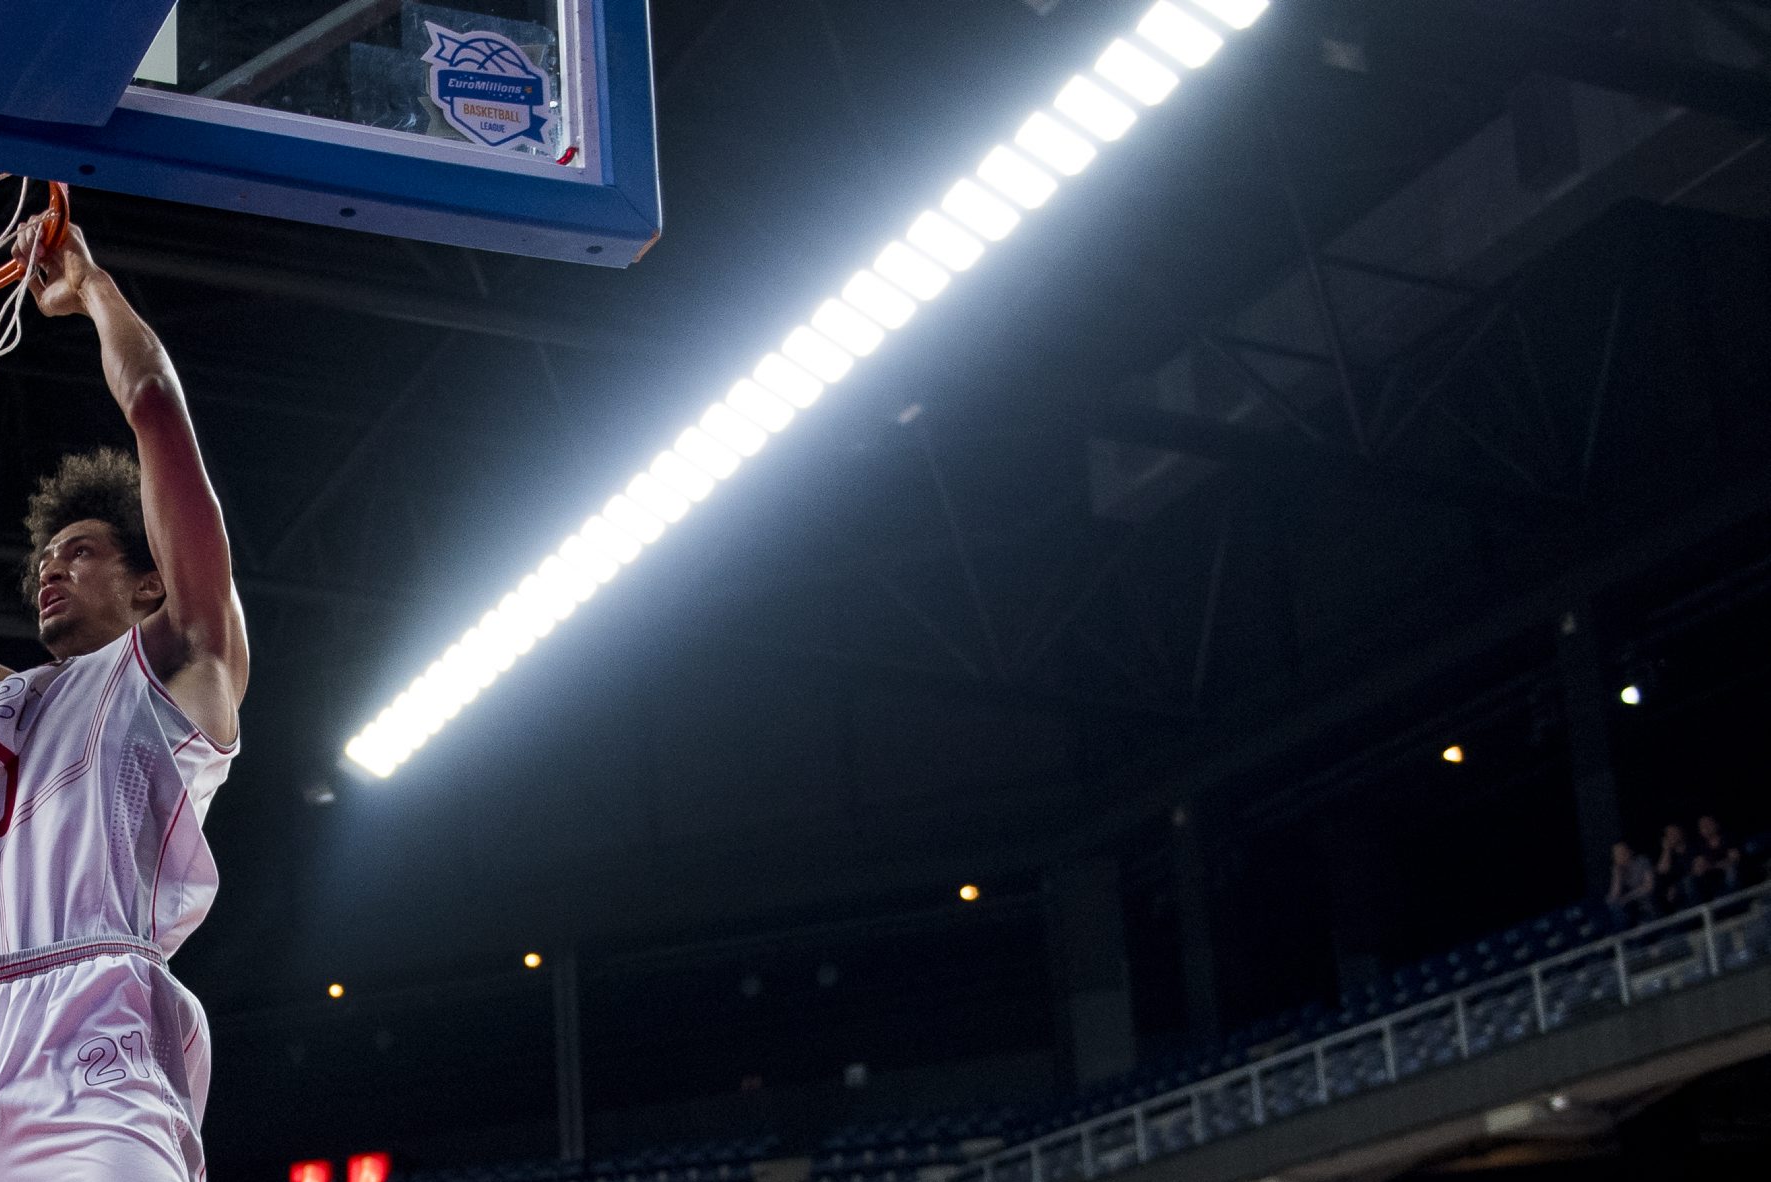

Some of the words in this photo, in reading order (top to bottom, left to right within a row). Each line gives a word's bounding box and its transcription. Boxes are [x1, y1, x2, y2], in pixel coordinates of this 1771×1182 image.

[447, 78, 522, 94] EuroMillions
[463, 103, 521, 123] BASKETBALL
[480, 121, 506, 133] LEAGUE
[77, 1031, 152, 1087] 21
